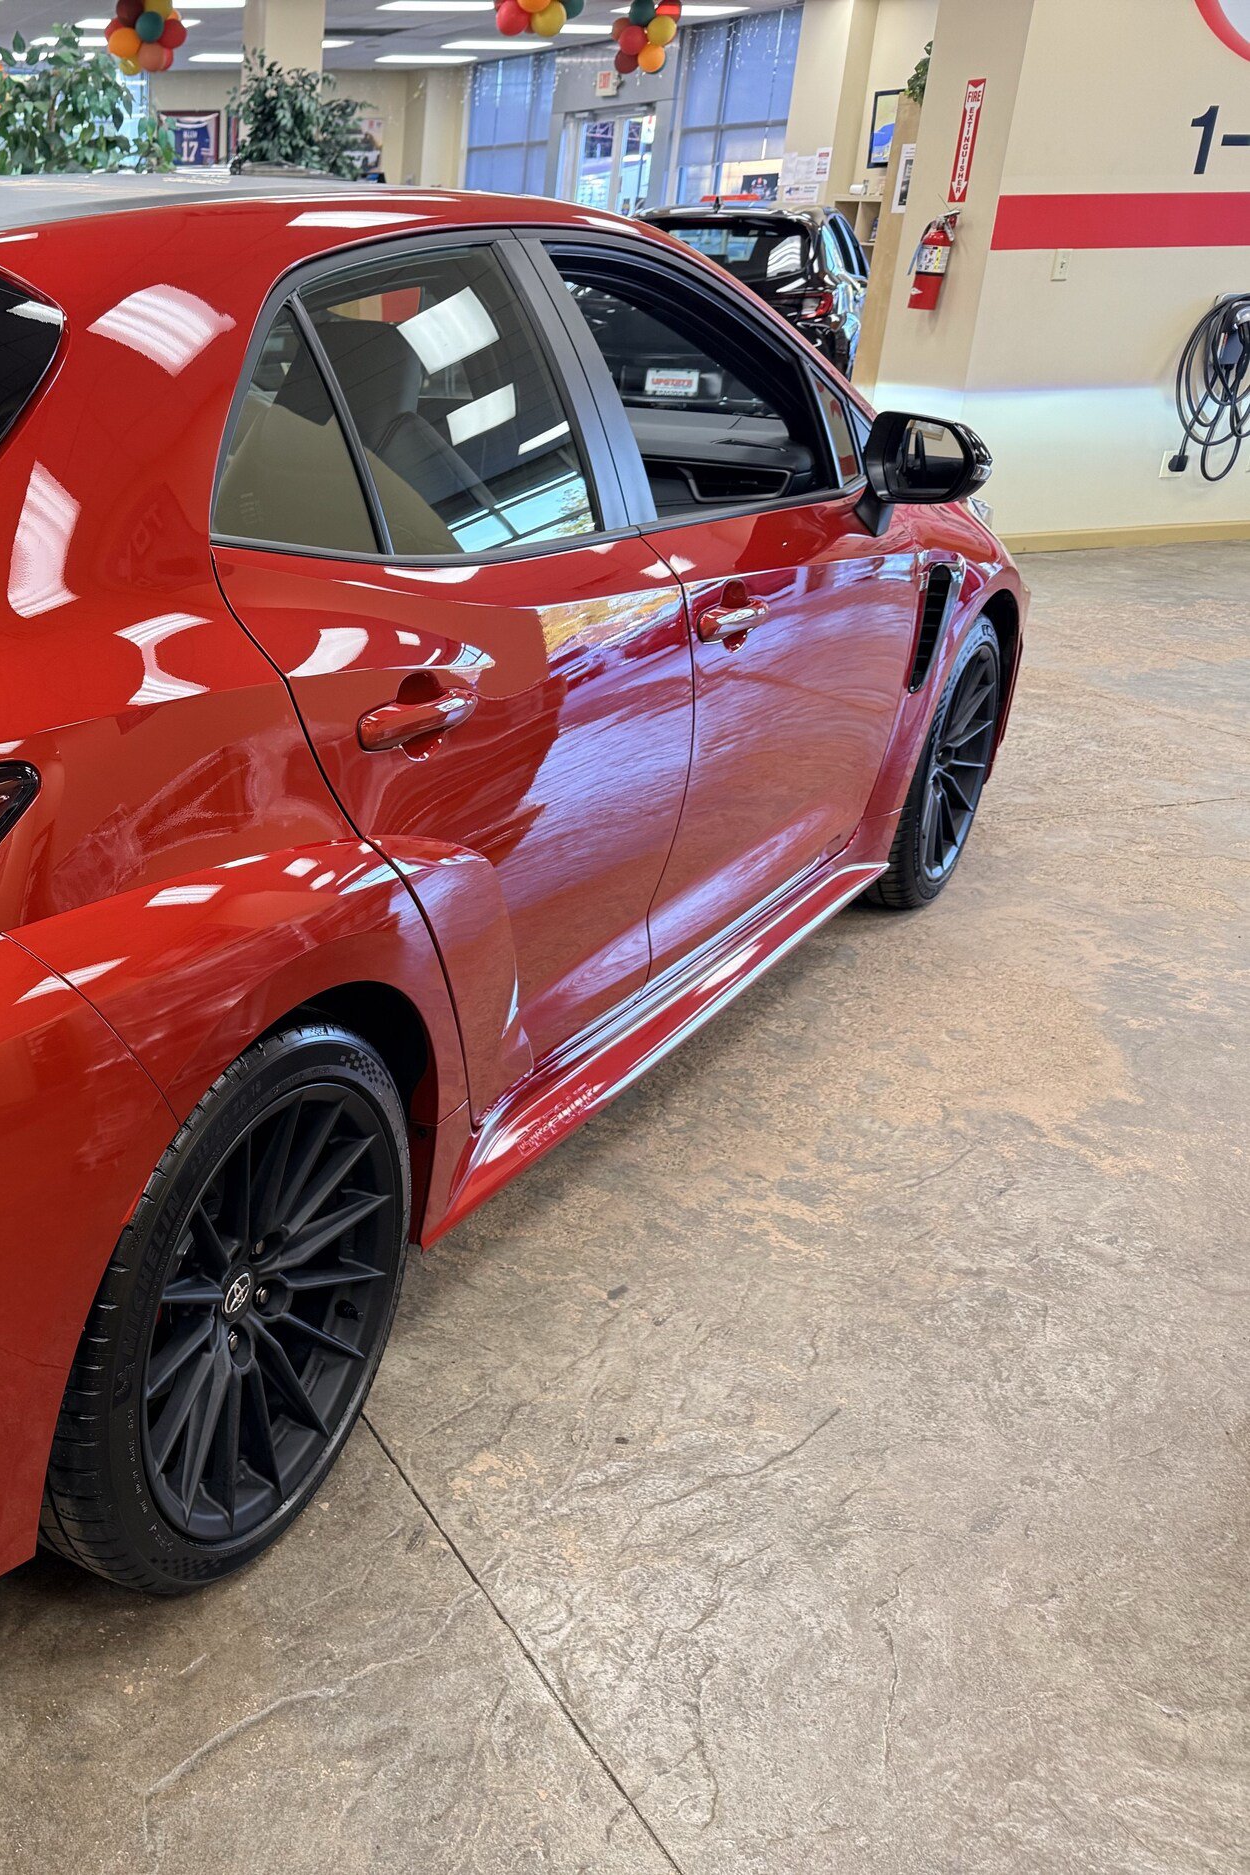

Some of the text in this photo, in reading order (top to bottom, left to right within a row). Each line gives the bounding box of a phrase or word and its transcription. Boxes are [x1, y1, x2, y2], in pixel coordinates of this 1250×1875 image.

[967, 90, 982, 102] FIRE
[181, 141, 199, 162] 17
[955, 106, 975, 193] EXTINGUISHER
